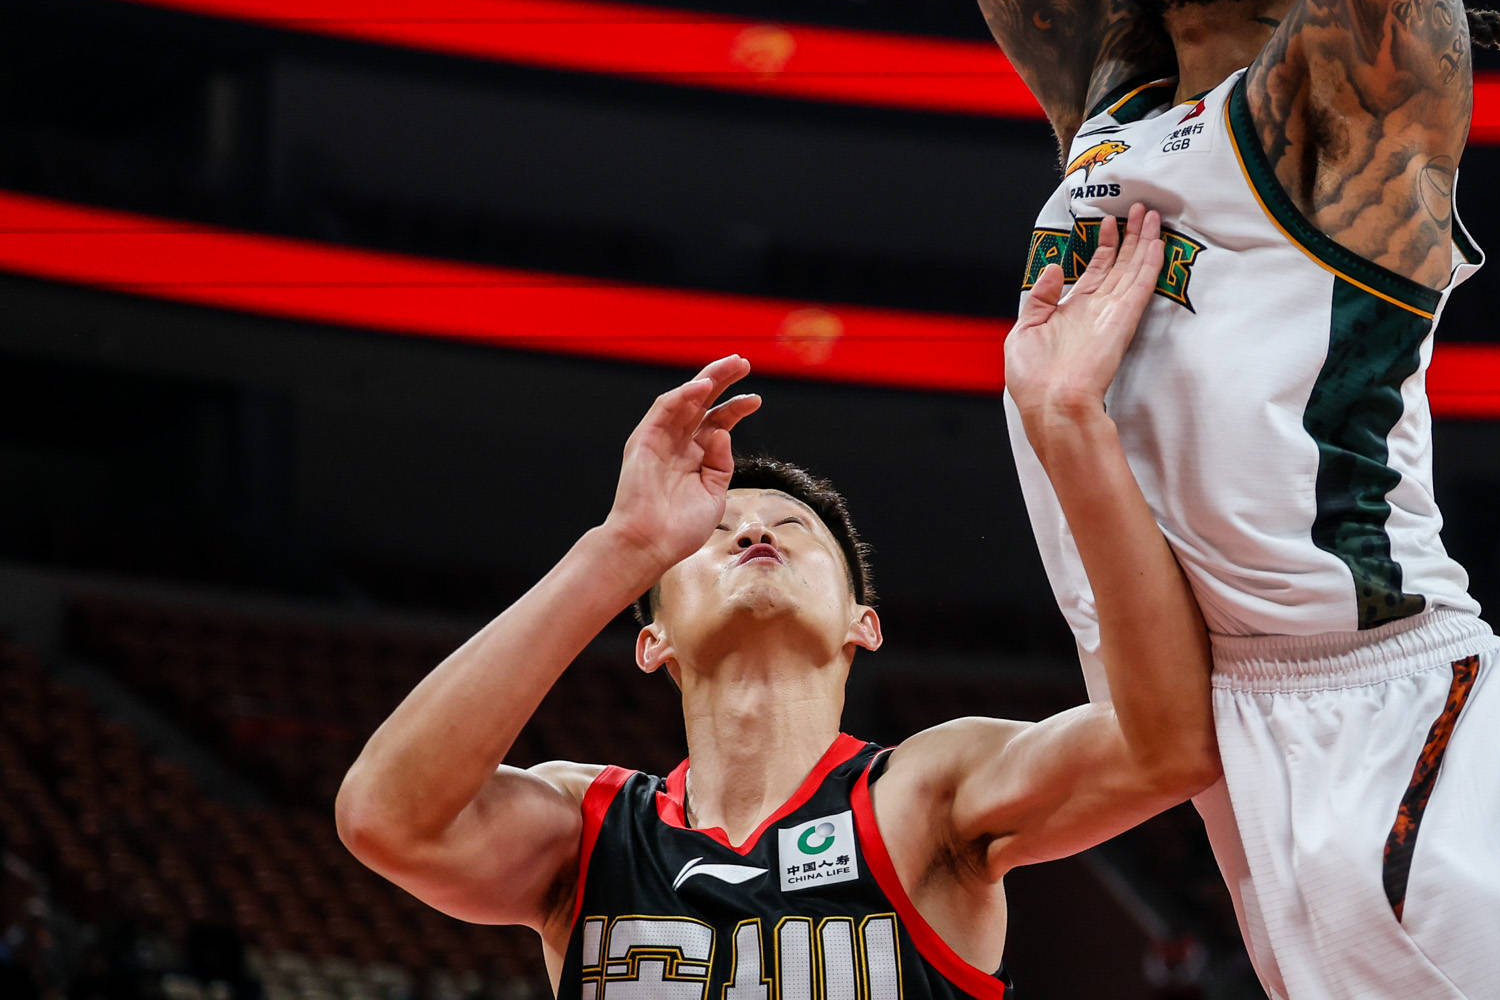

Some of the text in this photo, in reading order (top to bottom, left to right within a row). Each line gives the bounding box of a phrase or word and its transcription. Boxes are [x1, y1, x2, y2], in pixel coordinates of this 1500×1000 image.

[1162, 138, 1190, 153] CGB
[787, 854, 850, 876] 中国人寿
[787, 866, 850, 884] CHINA LIFE
